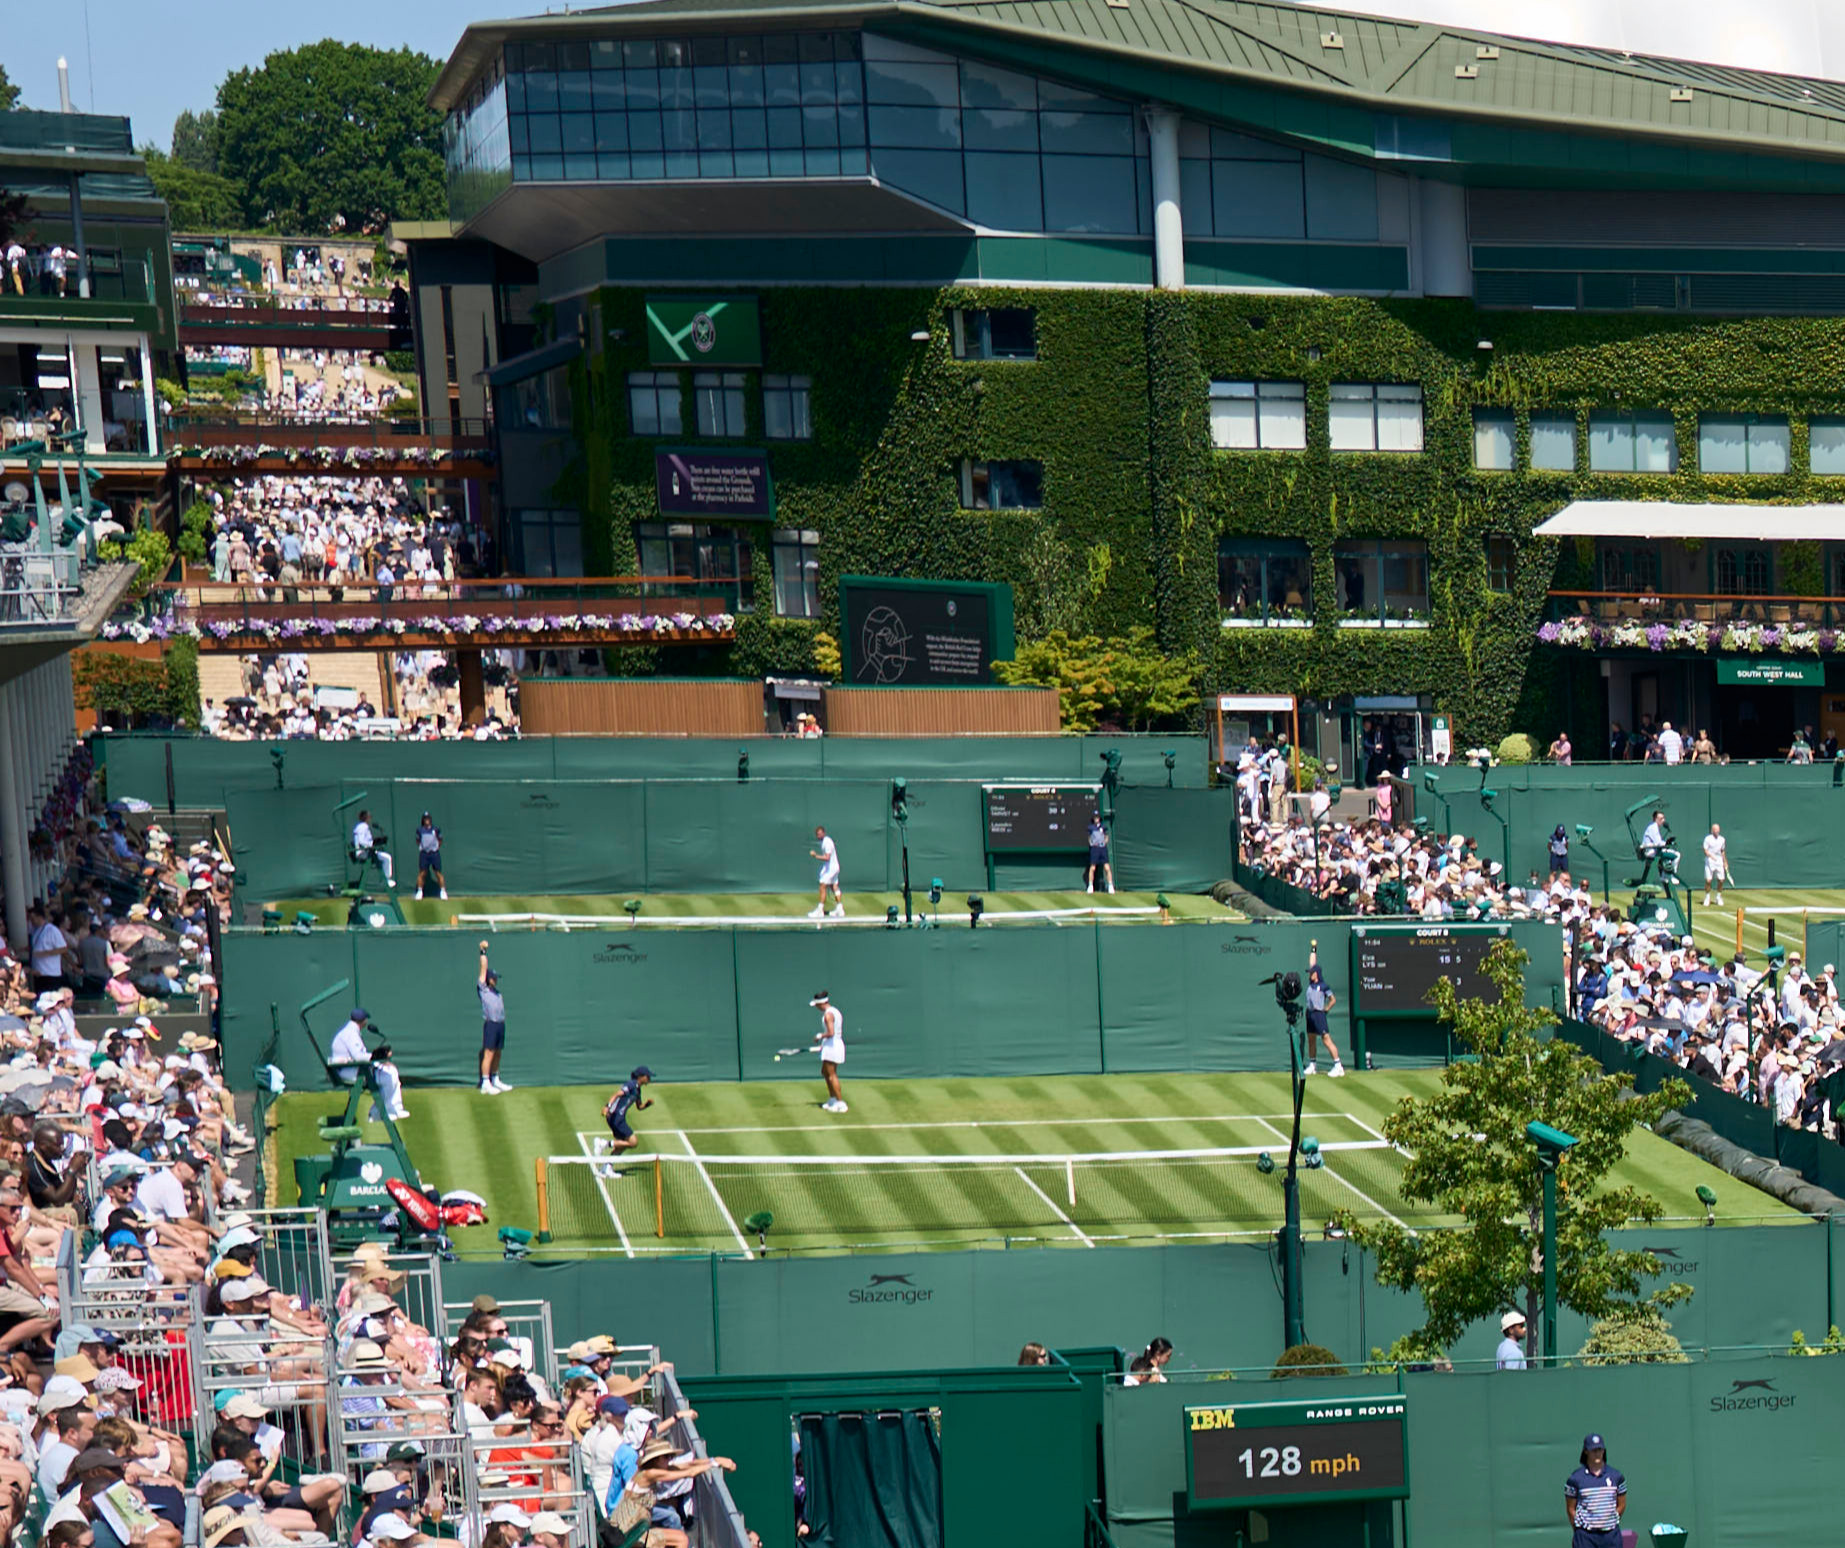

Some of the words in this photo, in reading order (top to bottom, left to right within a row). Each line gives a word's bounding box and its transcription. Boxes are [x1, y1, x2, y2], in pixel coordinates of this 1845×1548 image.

[1737, 670, 1761, 678] SOUTH
[1784, 671, 1803, 679] HALL
[1416, 929, 1443, 937] COURT
[1220, 943, 1273, 956] Slazenger
[593, 952, 648, 965] Slazenger
[350, 1186, 388, 1196] BARCLA
[407, 1198, 431, 1224] YONEX
[848, 1288, 934, 1304] Slazenger
[1710, 1394, 1798, 1413] Slazenger
[1306, 1408, 1353, 1419] RANGE
[1358, 1405, 1404, 1417] ROVER
[1190, 1408, 1236, 1431] IBM
[1238, 1446, 1303, 1478] 128
[1310, 1453, 1361, 1478] mph
